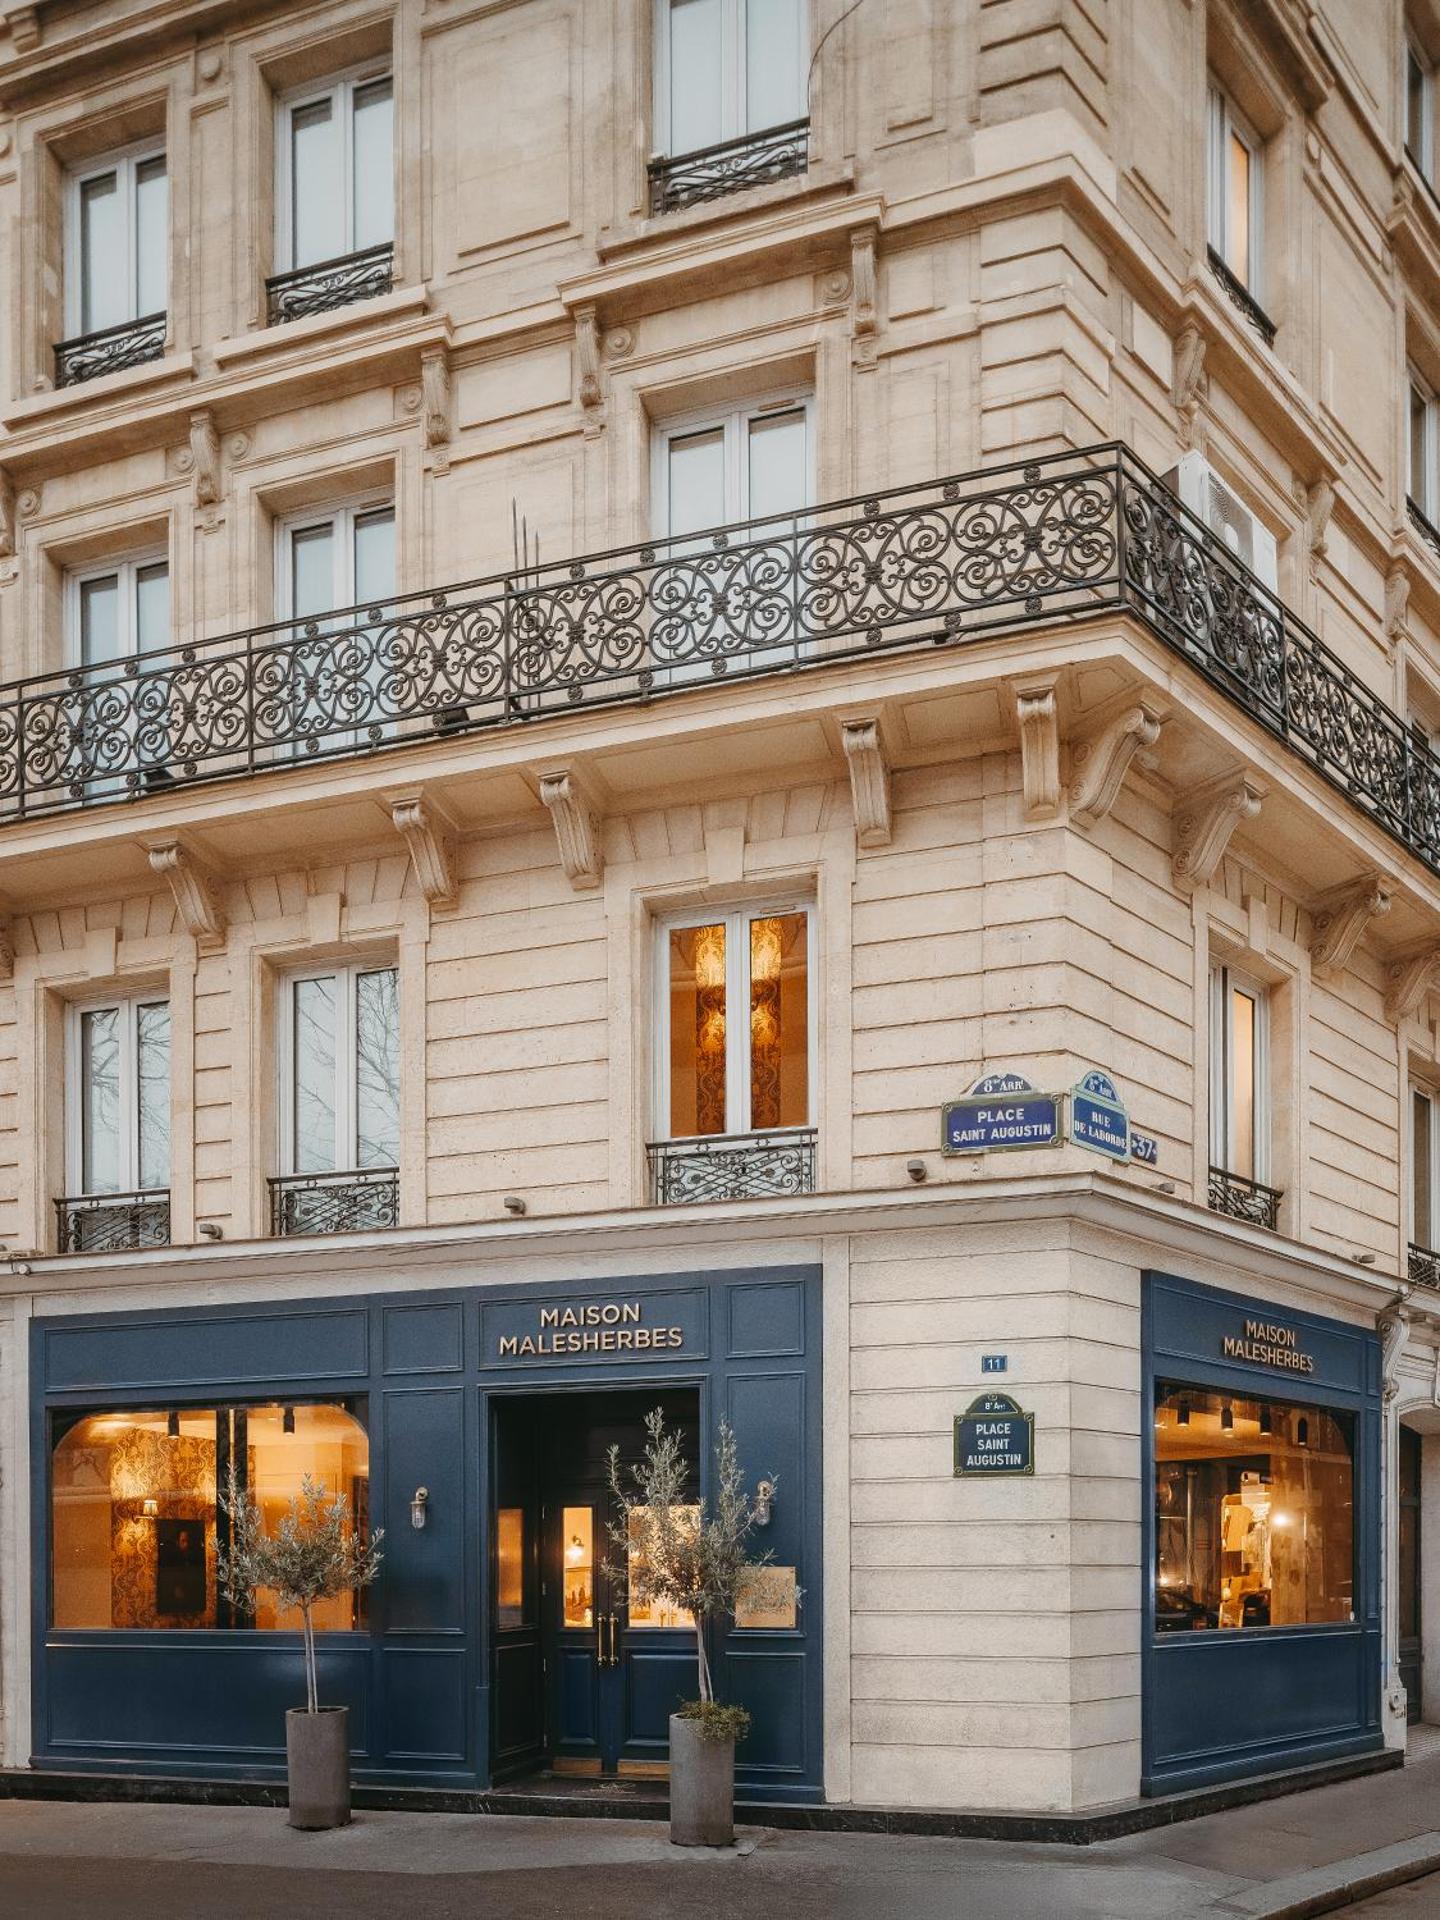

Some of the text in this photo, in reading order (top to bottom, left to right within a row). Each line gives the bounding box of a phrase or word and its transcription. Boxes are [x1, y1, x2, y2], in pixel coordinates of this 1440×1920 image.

[977, 1108, 1025, 1123] PLACE
[1092, 1111, 1111, 1128] RUE
[953, 1123, 1051, 1142] SAINT AUGUSTIN
[1074, 1120, 1127, 1149] DE LABORDE
[540, 1303, 641, 1328] MAISON
[500, 1327, 683, 1355] MALESHERBES
[1246, 1320, 1295, 1347] MAISON
[1224, 1336, 1313, 1372] MALESHERBES
[988, 1358, 1000, 1370] 11
[976, 1423, 1011, 1435] PLACE
[977, 1438, 1010, 1450] SAINT
[967, 1454, 1021, 1467] AUGUSTIN
